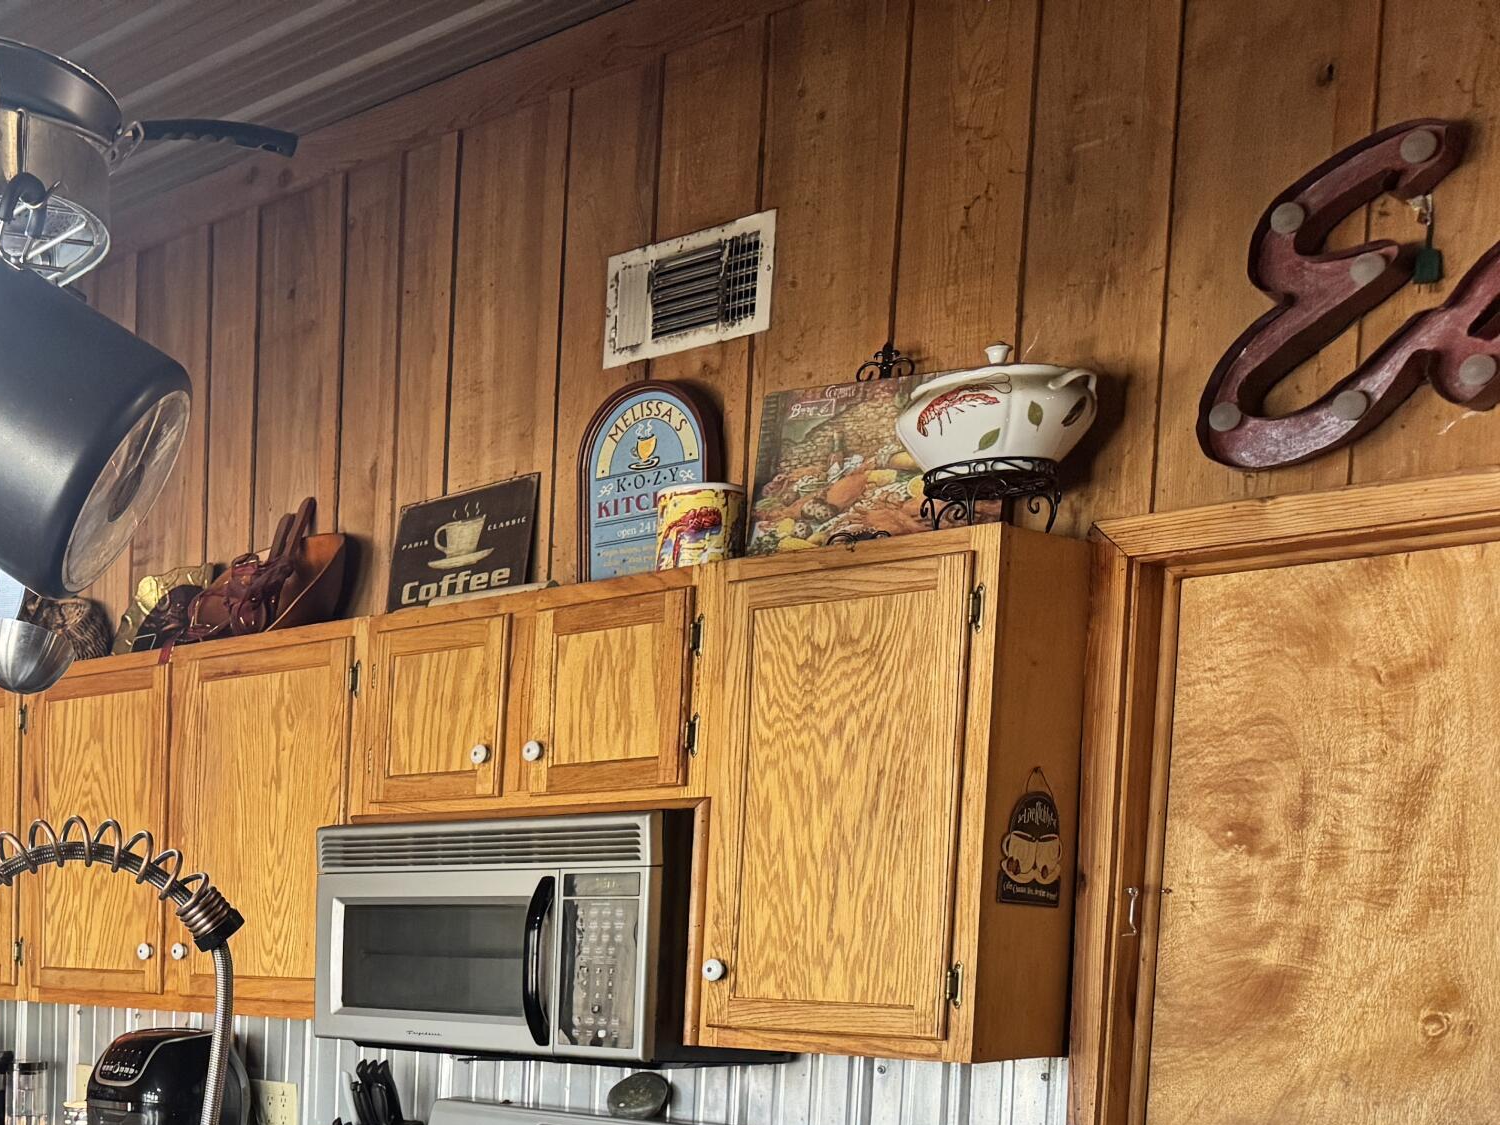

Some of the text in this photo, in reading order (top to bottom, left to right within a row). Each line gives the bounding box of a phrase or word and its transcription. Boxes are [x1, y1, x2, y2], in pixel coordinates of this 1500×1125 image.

[608, 400, 688, 444] MELISSA'S
[596, 492, 657, 520] KITC
[487, 516, 527, 531] CLASSIC
[616, 525, 637, 539] open
[639, 522, 651, 534] 24
[401, 539, 429, 551] PARIS
[401, 567, 511, 605] Coffee
